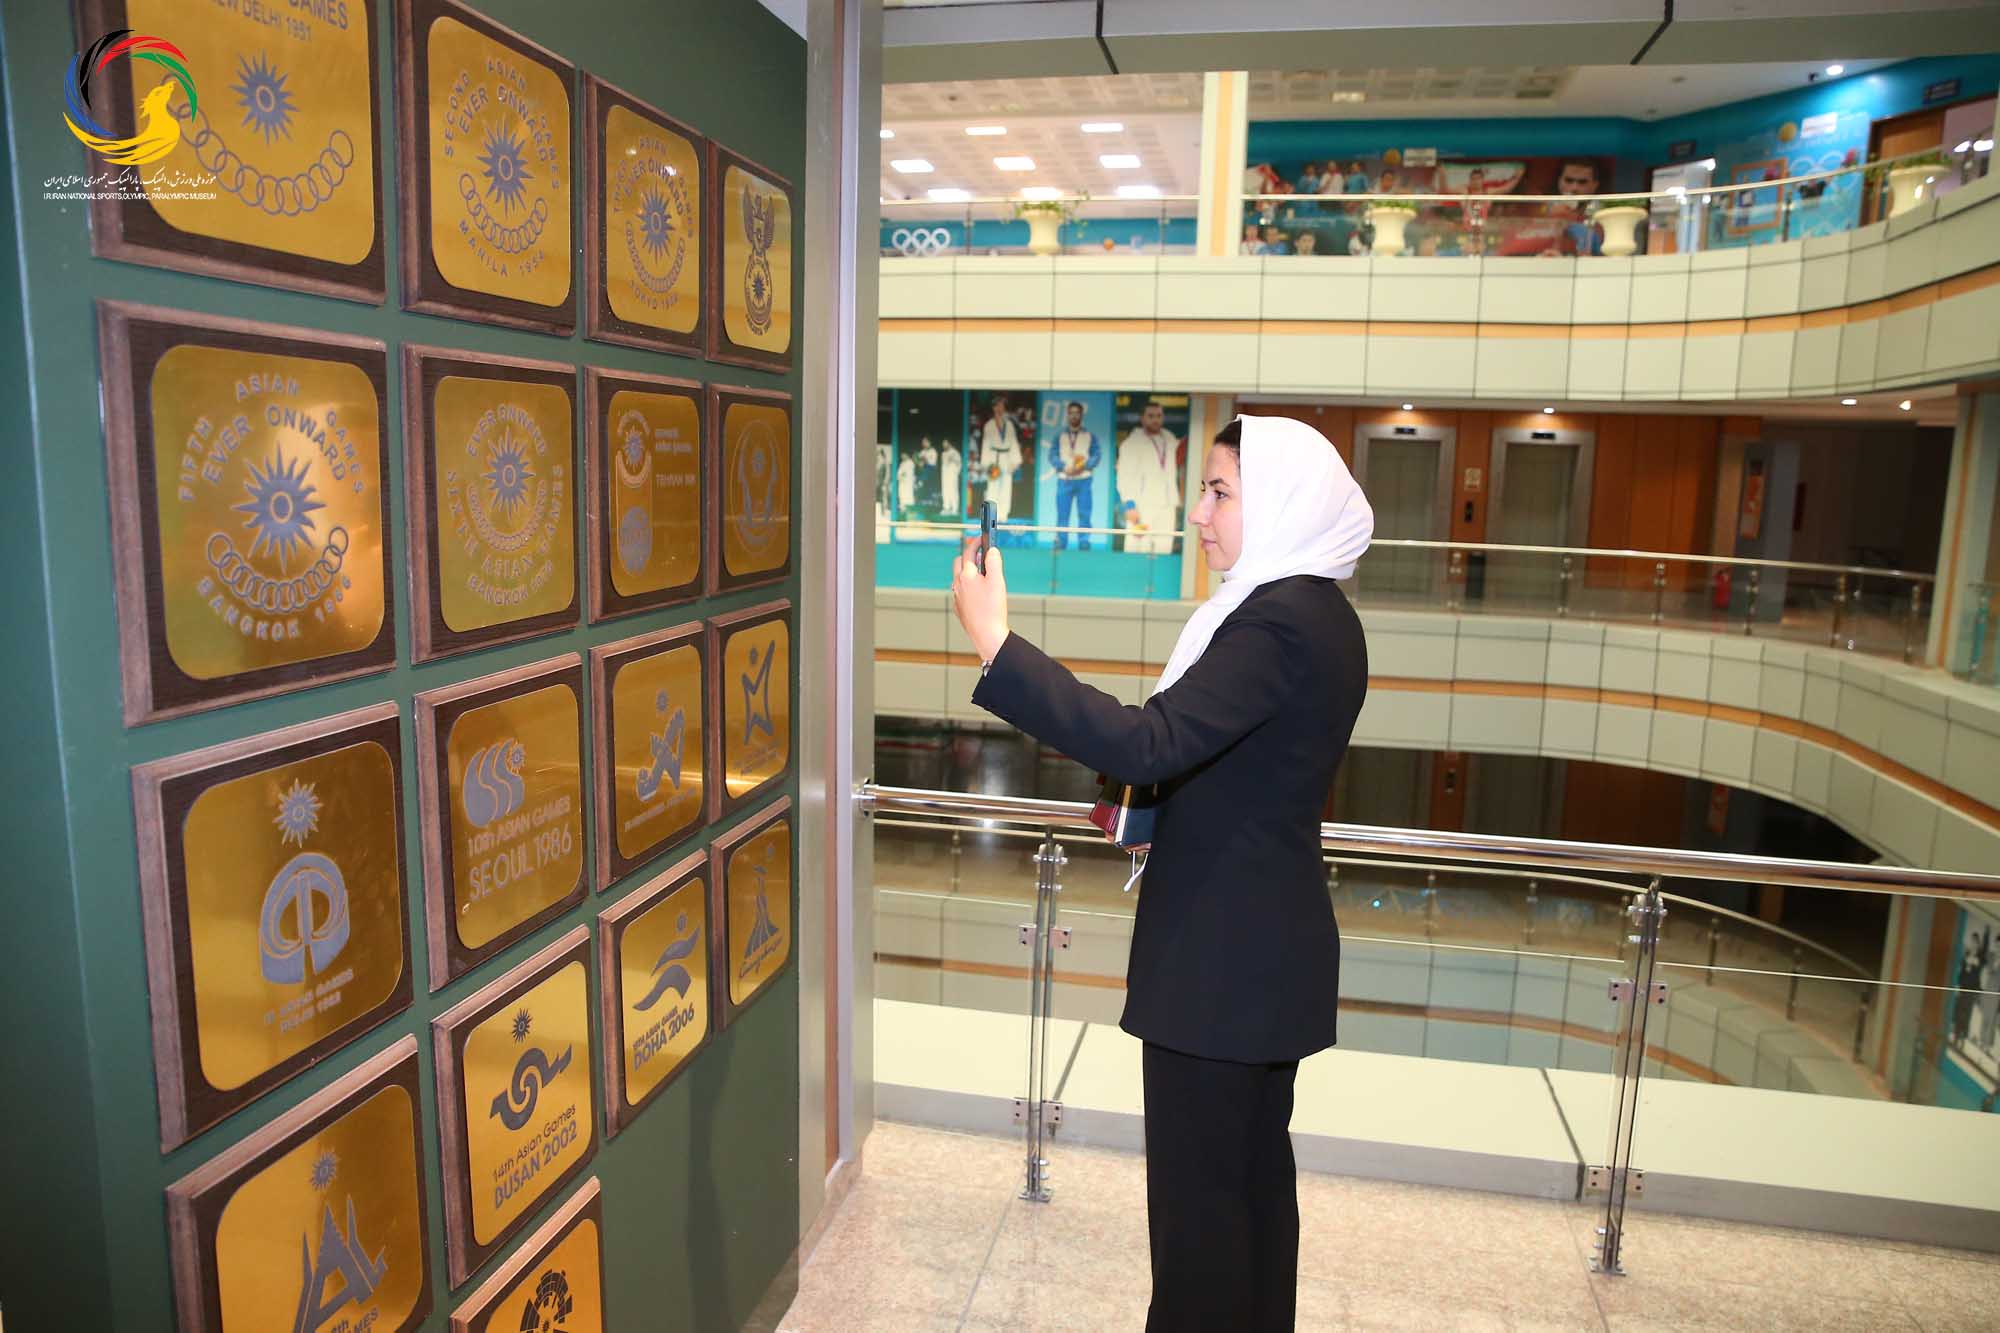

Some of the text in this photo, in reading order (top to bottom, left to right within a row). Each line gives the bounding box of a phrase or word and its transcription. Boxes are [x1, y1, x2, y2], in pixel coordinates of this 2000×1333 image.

[486, 58, 526, 92] ASIAN
[459, 87, 489, 134] EVER
[459, 218, 508, 277] MANILA
[179, 372, 365, 502] FIFTH ASIAN GAMES
[202, 403, 347, 486] EVER ONWARD
[197, 576, 300, 642] BANGKOK
[469, 822, 572, 902] SEOUL 1986
[634, 1001, 695, 1072] DOHA 2006
[516, 1133, 543, 1164] Asian
[543, 1103, 576, 1139] Games
[543, 1119, 577, 1167] 2002
